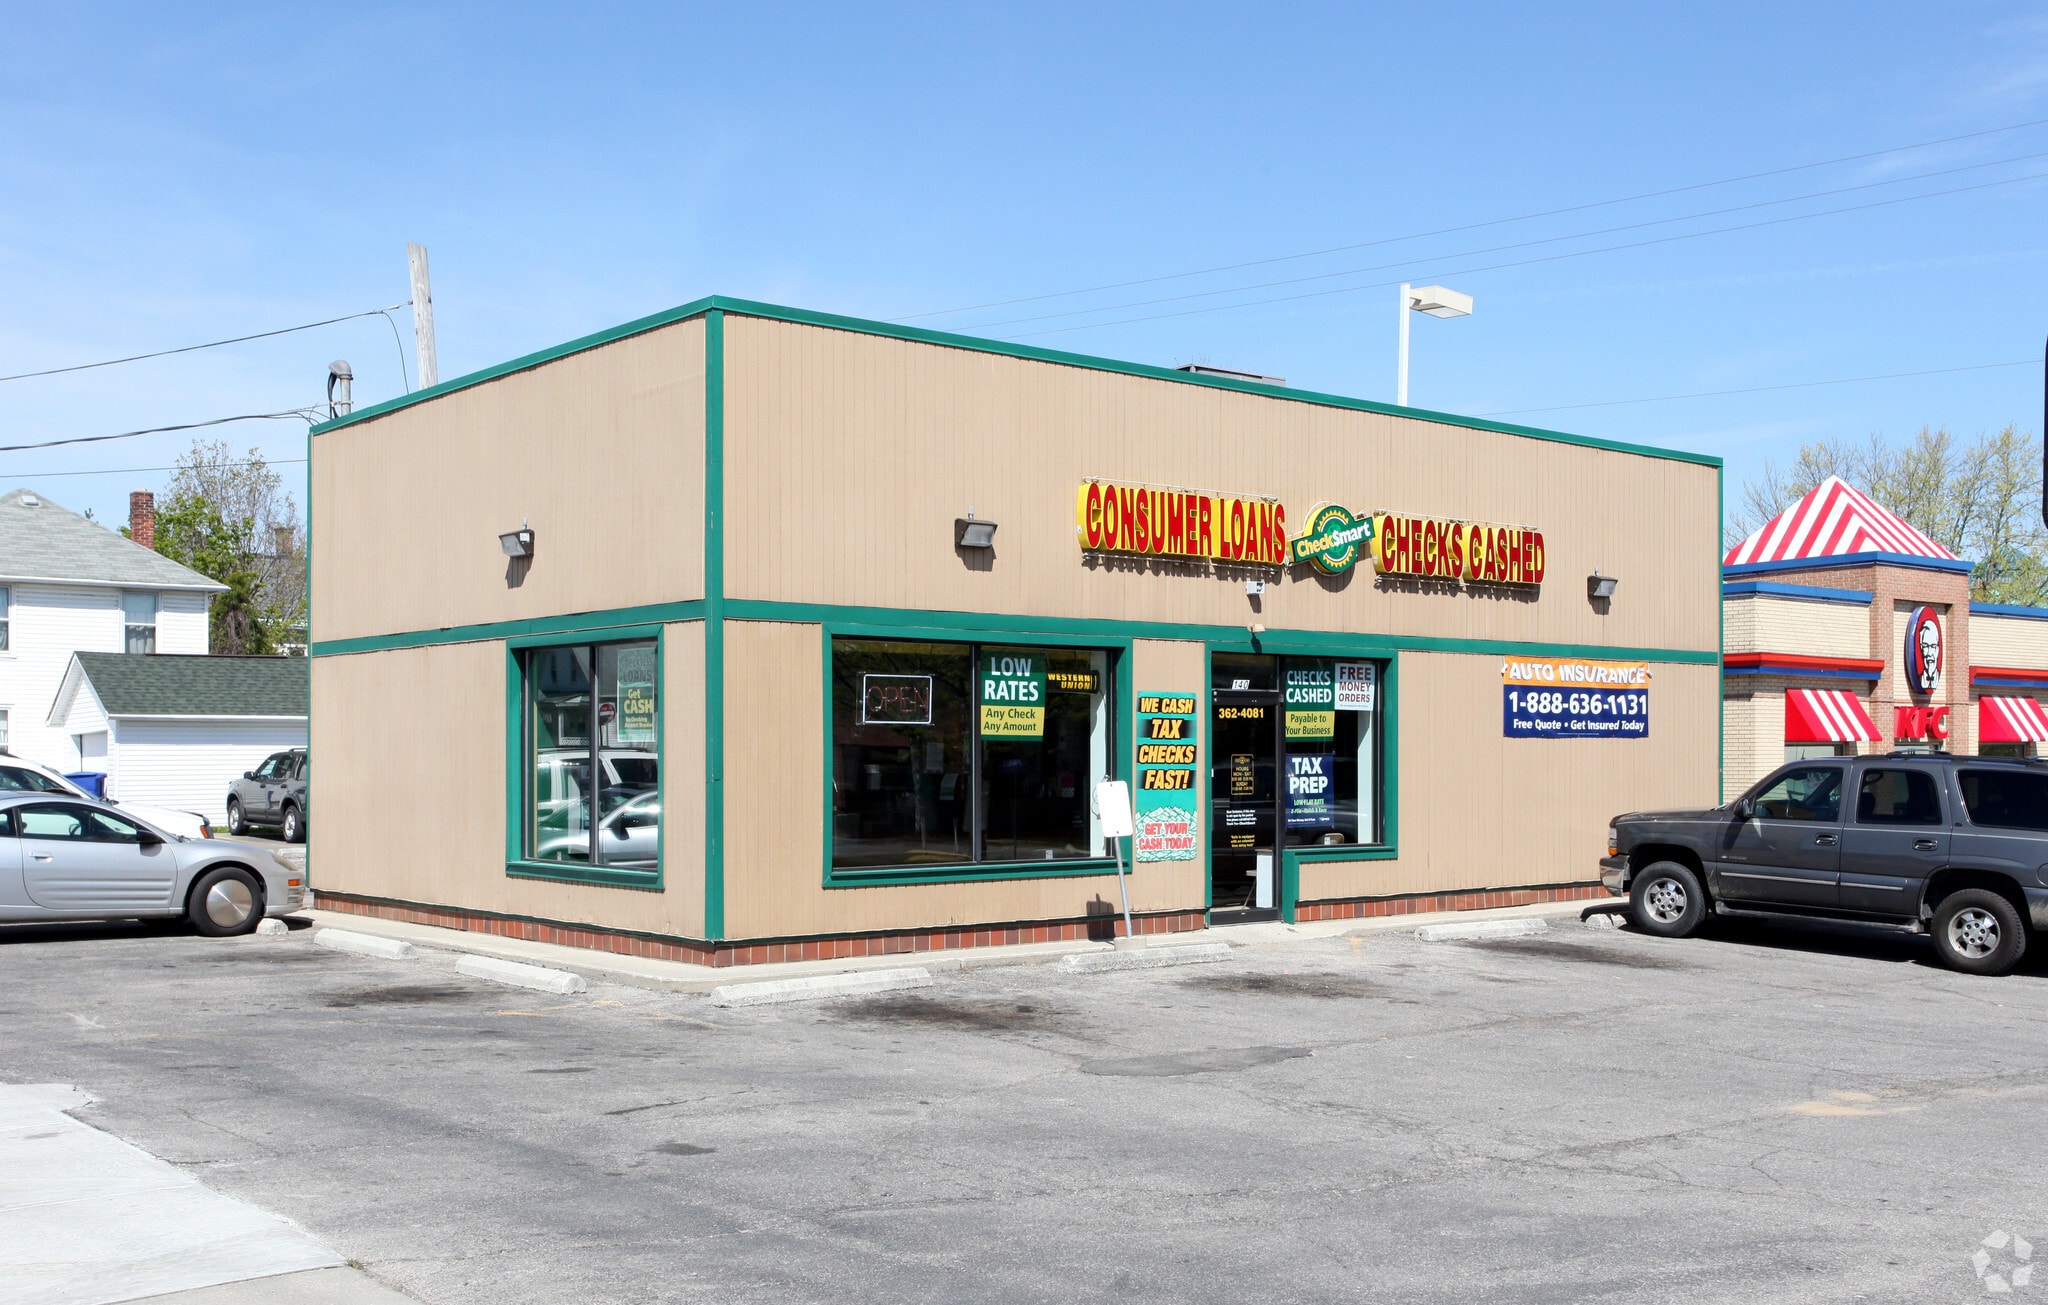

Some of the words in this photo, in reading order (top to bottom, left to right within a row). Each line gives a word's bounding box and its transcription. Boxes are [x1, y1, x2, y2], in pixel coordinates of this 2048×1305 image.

[1084, 482, 1213, 557] CONSUMER
[1219, 498, 1286, 565] LOANS
[1381, 514, 1464, 579] CHECKS
[1468, 524, 1546, 584] CASHED
[990, 656, 1032, 677] LOW
[1339, 666, 1372, 681] FREE
[1509, 662, 1555, 681] AUTO
[1558, 664, 1646, 684] INSURANCE
[623, 669, 652, 683] LOANS
[1047, 673, 1091, 682] WESTERN
[1286, 670, 1331, 686] CHECKS
[984, 679, 1039, 702] RATES
[1060, 681, 1091, 690] UNION
[1234, 680, 1249, 690] 140
[1338, 682, 1371, 692] MONEY
[627, 688, 641, 699] Get
[866, 685, 929, 713] OPEN
[1286, 687, 1332, 704] CASHED
[1338, 693, 1370, 703] ORDERS
[623, 699, 653, 714] CASH
[1140, 697, 1159, 713] WE
[1161, 697, 1194, 714] CASH
[1508, 691, 1647, 715] 1-888-636-1131
[985, 708, 1005, 721] Any
[1007, 708, 1036, 720] Check
[1218, 707, 1264, 719] 362-4081
[1290, 713, 1318, 726] Payable
[1319, 713, 1327, 723] to
[983, 721, 1001, 733] Any
[1002, 721, 1037, 732] Amount
[1151, 718, 1183, 739] TAX
[1513, 718, 1533, 729] Free
[1535, 719, 1562, 731] Quote
[1570, 720, 1586, 730] Get
[1587, 720, 1620, 730] Insured
[1621, 720, 1645, 733] Today
[1894, 706, 1950, 739] KFC
[1285, 726, 1301, 736] Your
[1302, 725, 1331, 735] Business
[1138, 744, 1195, 764] CHECKS
[1291, 757, 1323, 775] TAX
[1144, 769, 1190, 790] FAST!
[1289, 776, 1329, 795] PREP
[1144, 822, 1163, 836] GET
[1164, 822, 1188, 836] YOUR
[1138, 837, 1163, 851] CASH
[1164, 836, 1194, 850] TODAY
